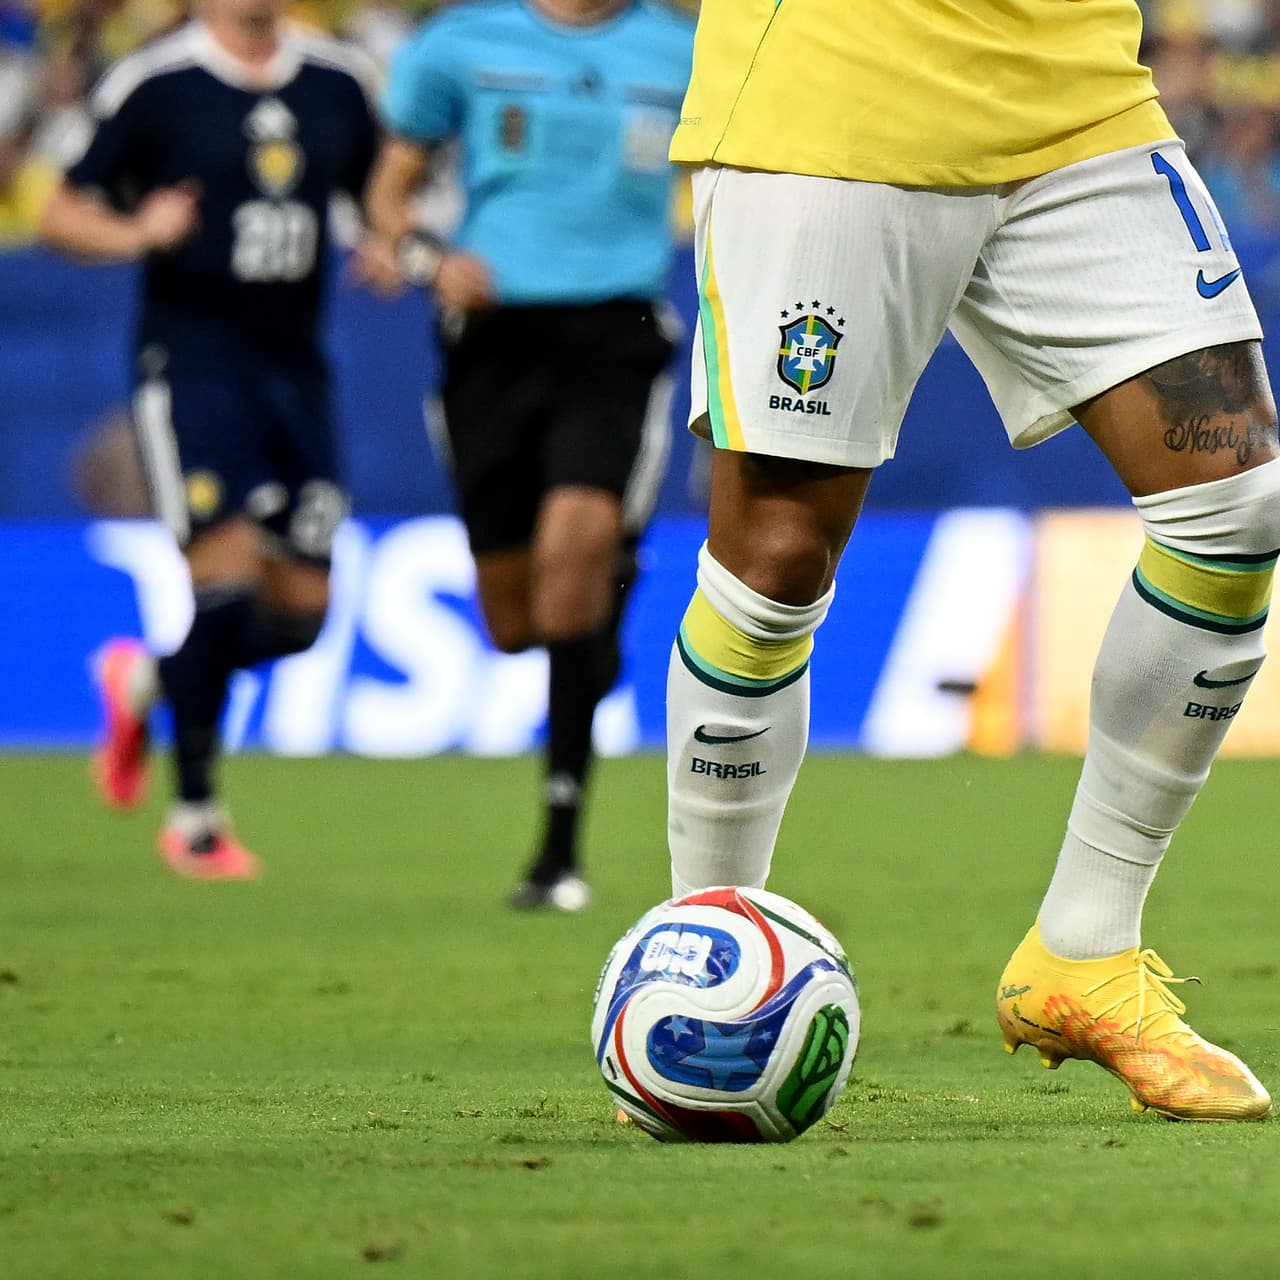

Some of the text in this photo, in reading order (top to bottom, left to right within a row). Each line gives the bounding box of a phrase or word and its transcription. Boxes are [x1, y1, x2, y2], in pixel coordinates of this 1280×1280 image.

[1150, 151, 1233, 253] 1
[796, 346, 821, 358] CBF
[768, 395, 832, 416] BRASIL
[691, 757, 767, 779] BRASIL
